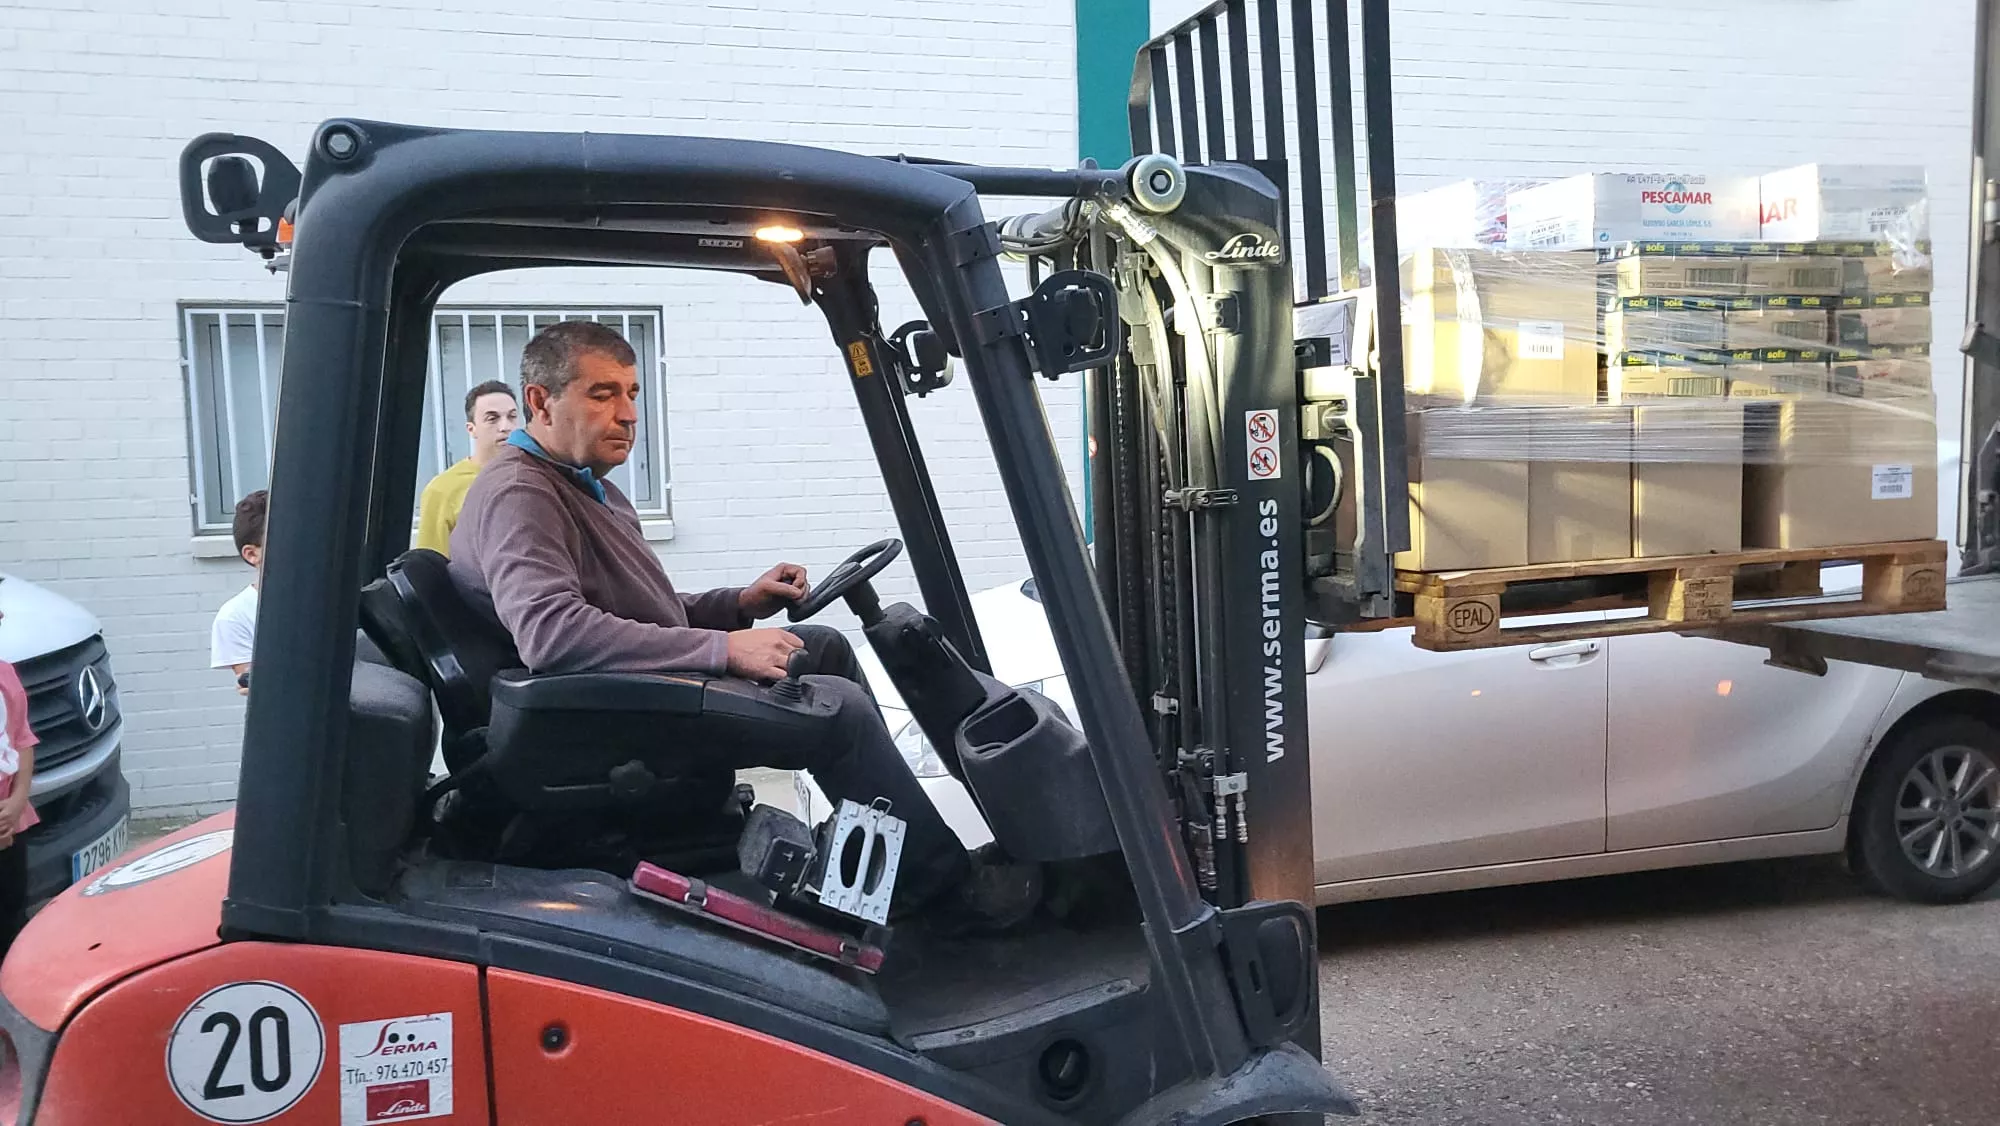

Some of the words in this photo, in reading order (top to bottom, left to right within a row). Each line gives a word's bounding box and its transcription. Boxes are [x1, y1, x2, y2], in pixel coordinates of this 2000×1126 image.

[1641, 191, 1712, 204] PESCAMAR
[1204, 233, 1280, 259] Linde
[1454, 607, 1487, 628] EPAL
[1259, 499, 1285, 763] www.serma.es
[83, 836, 111, 877] 2796
[354, 1021, 438, 1058] SERMA
[199, 1005, 292, 1101] 20
[345, 1068, 373, 1084] Tfn.:
[376, 1064, 398, 1080] 976
[402, 1060, 424, 1077] 470
[427, 1058, 448, 1074] 457
[377, 1099, 426, 1116] Linde
